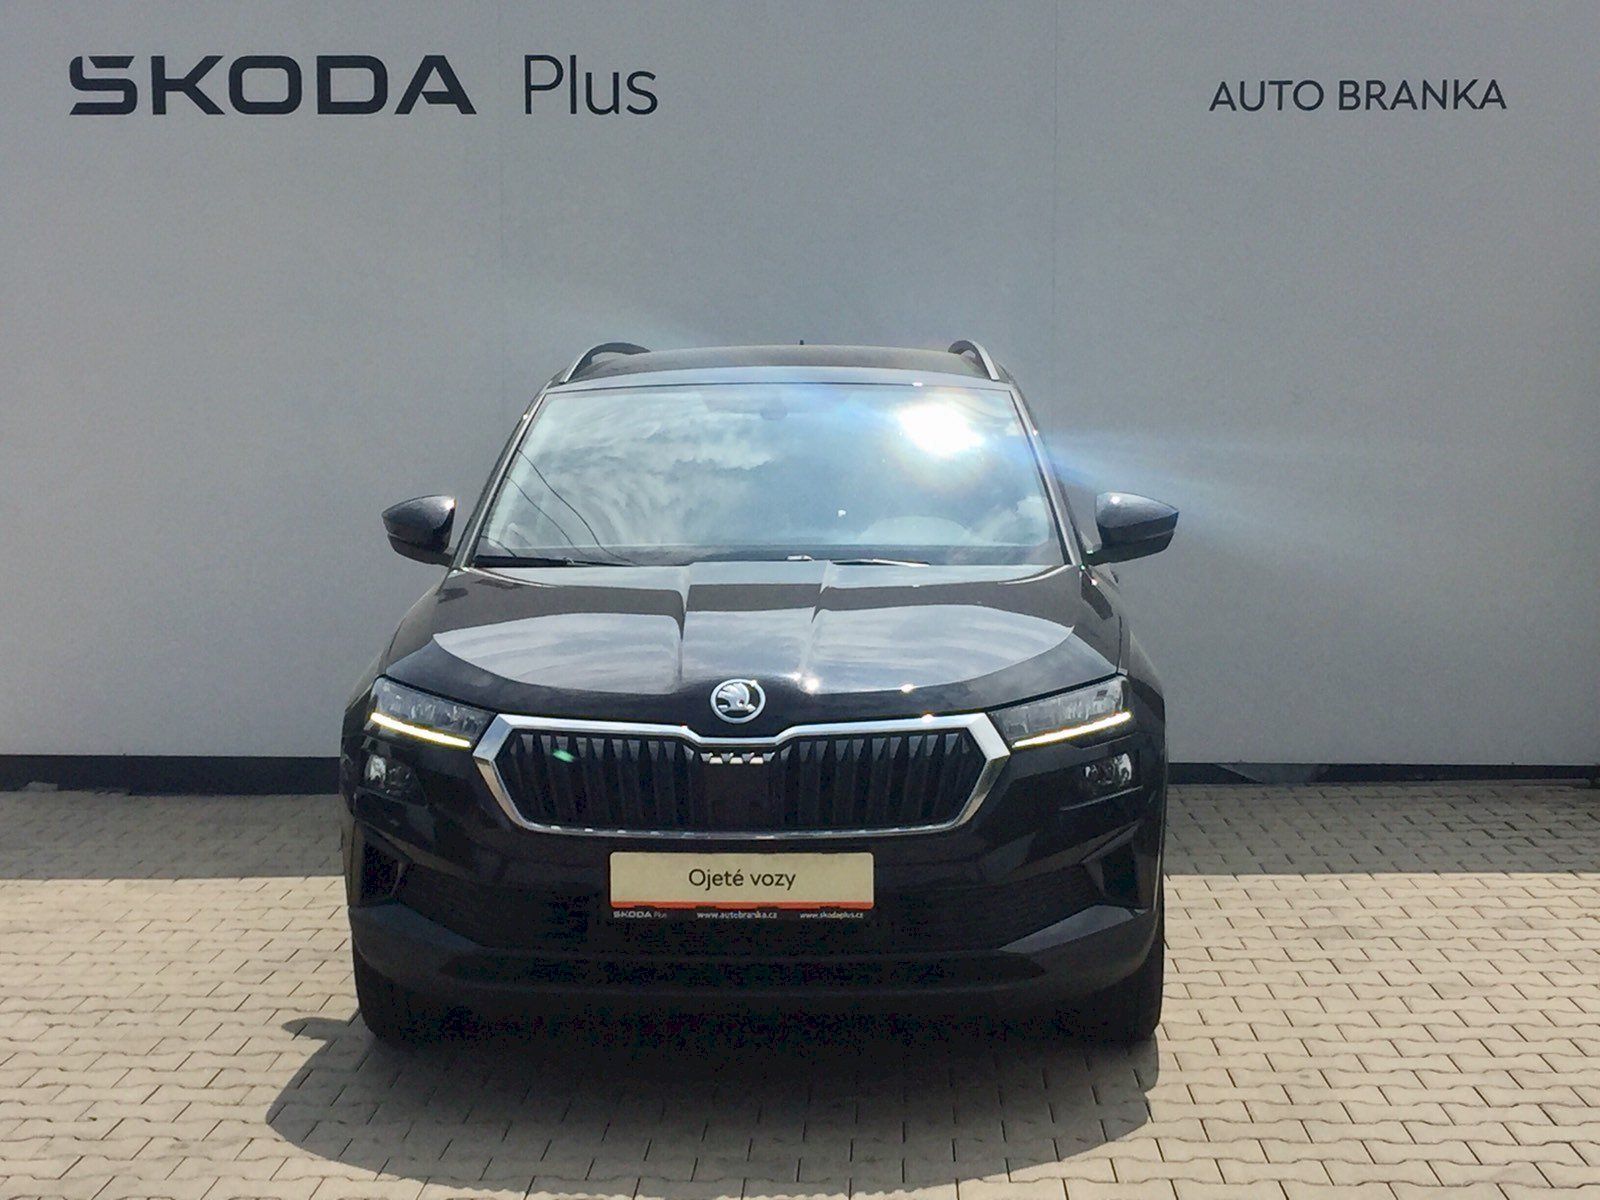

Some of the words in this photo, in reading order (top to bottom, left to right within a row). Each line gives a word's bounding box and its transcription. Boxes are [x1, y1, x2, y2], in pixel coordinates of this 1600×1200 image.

[524, 54, 659, 115] Plus
[1208, 79, 1325, 111] AUTO
[1338, 79, 1508, 111] BRANKA
[688, 868, 745, 891] Ojeté
[749, 873, 797, 891] vozy
